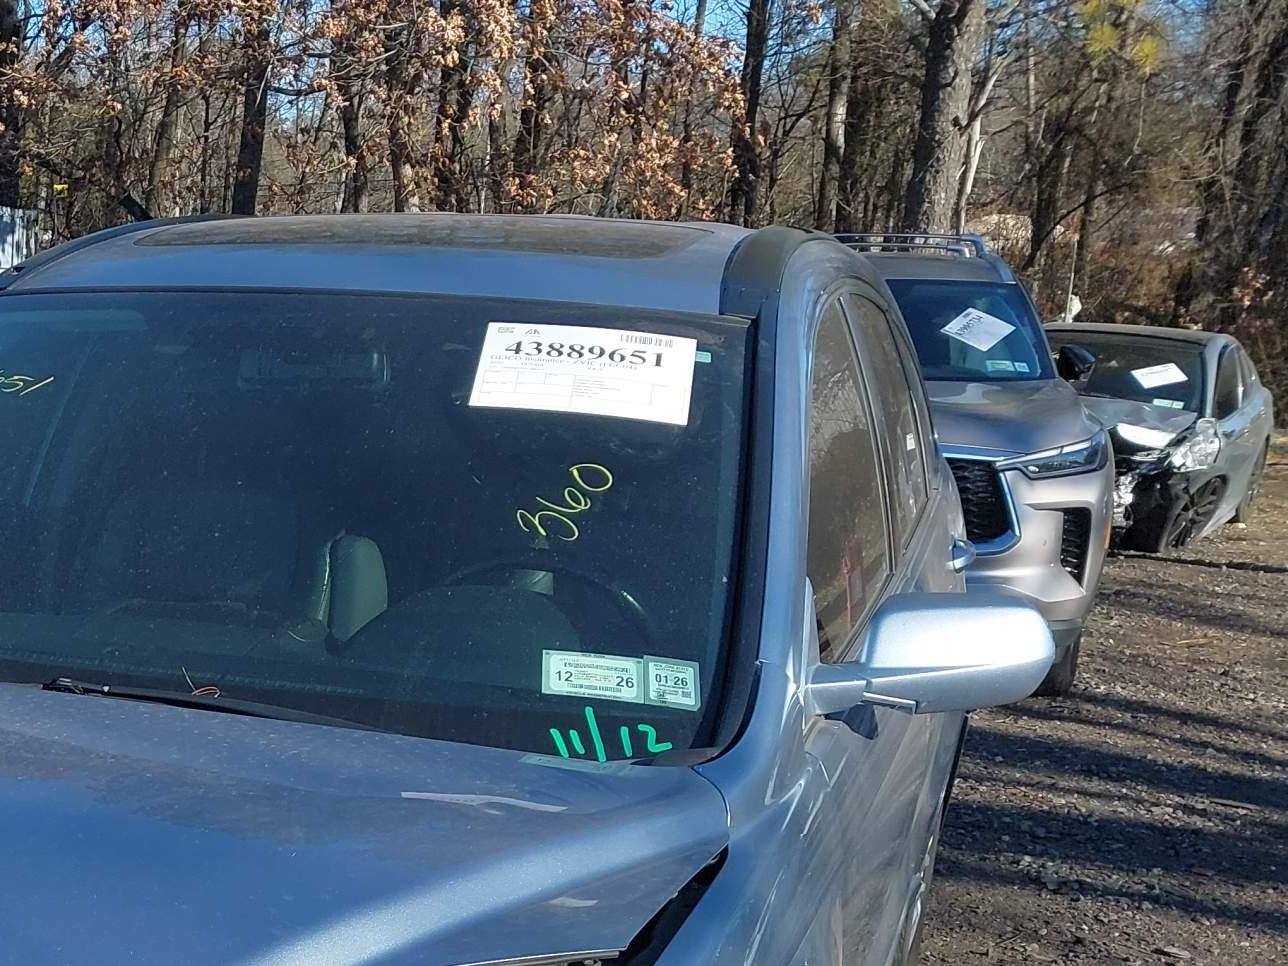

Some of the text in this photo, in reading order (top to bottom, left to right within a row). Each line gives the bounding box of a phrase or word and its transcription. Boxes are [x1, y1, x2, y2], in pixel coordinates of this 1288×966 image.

[504, 340, 664, 368] 43889651
[516, 463, 614, 542] 360
[555, 670, 574, 683] 12
[615, 675, 635, 689] 26
[549, 705, 673, 763] 11/12
